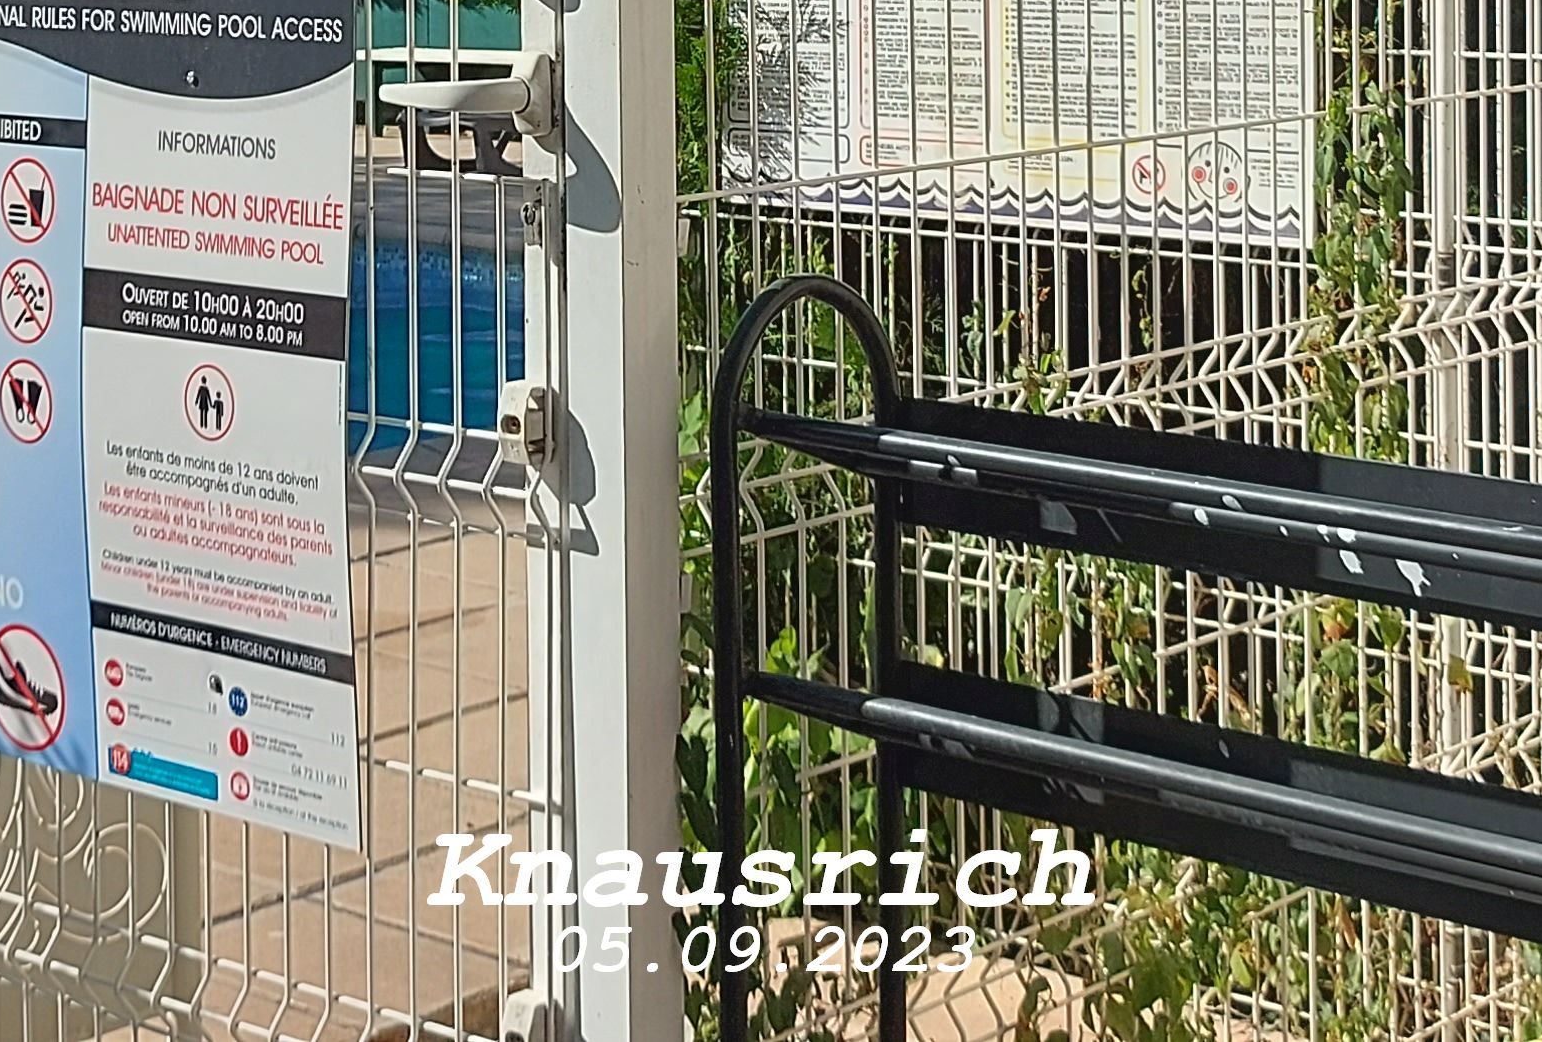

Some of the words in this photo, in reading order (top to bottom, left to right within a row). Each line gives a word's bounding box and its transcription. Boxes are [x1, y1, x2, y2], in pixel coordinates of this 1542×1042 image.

[31, 6, 76, 30] RULES
[81, 8, 115, 32] FOR
[120, 10, 212, 37] SWIMMING
[217, 14, 267, 40] POOL
[271, 16, 344, 43] ACCESS
[158, 130, 276, 160] INFORMATIONS
[92, 182, 185, 215] BAIGNADE
[191, 190, 237, 220] NON
[243, 193, 344, 230] SURVEILLÉE
[107, 222, 190, 250] UNATTENTED
[195, 231, 275, 259] SWIMMING
[281, 240, 324, 265] POOL
[122, 282, 170, 308] OUVERT
[172, 293, 189, 310] DE
[243, 295, 252, 318] À
[122, 309, 149, 327] OPEN
[151, 312, 180, 330] FROM
[183, 314, 218, 336] 10.00
[220, 323, 237, 339] AM
[239, 324, 253, 340] TO
[256, 324, 284, 345] 8.00
[287, 330, 303, 347] PM
[106, 440, 123, 457] Les
[126, 444, 164, 463] enfants
[167, 451, 181, 466] de
[184, 456, 215, 472] moins
[219, 460, 233, 476] de
[238, 462, 251, 478] 12
[254, 468, 273, 482] ans
[276, 469, 319, 491] doivent
[126, 462, 146, 478] être
[150, 468, 229, 493] accompagnés
[232, 480, 256, 497] d'un
[259, 486, 298, 506] adulte.
[99, 500, 170, 524] responsabilité
[173, 509, 184, 526] et
[187, 511, 197, 528] la
[200, 517, 264, 542] surveillance
[267, 529, 288, 546] des
[290, 535, 333, 556] parents
[104, 482, 121, 498] Les
[124, 486, 161, 504] enfants
[164, 494, 205, 513] mineurs
[220, 501, 232, 518] 18
[235, 505, 258, 526] ans)
[261, 509, 284, 526] sont
[287, 516, 311, 532] sous
[314, 518, 325, 535] la
[133, 523, 147, 536] ou
[150, 526, 188, 546] adultes
[191, 535, 297, 567] accompagnateurs.
[111, 612, 156, 636] NUMÉROS
[158, 622, 213, 647] D'URGENCE
[221, 635, 281, 663] EMERGENCY
[281, 649, 326, 674] NUMBERS
